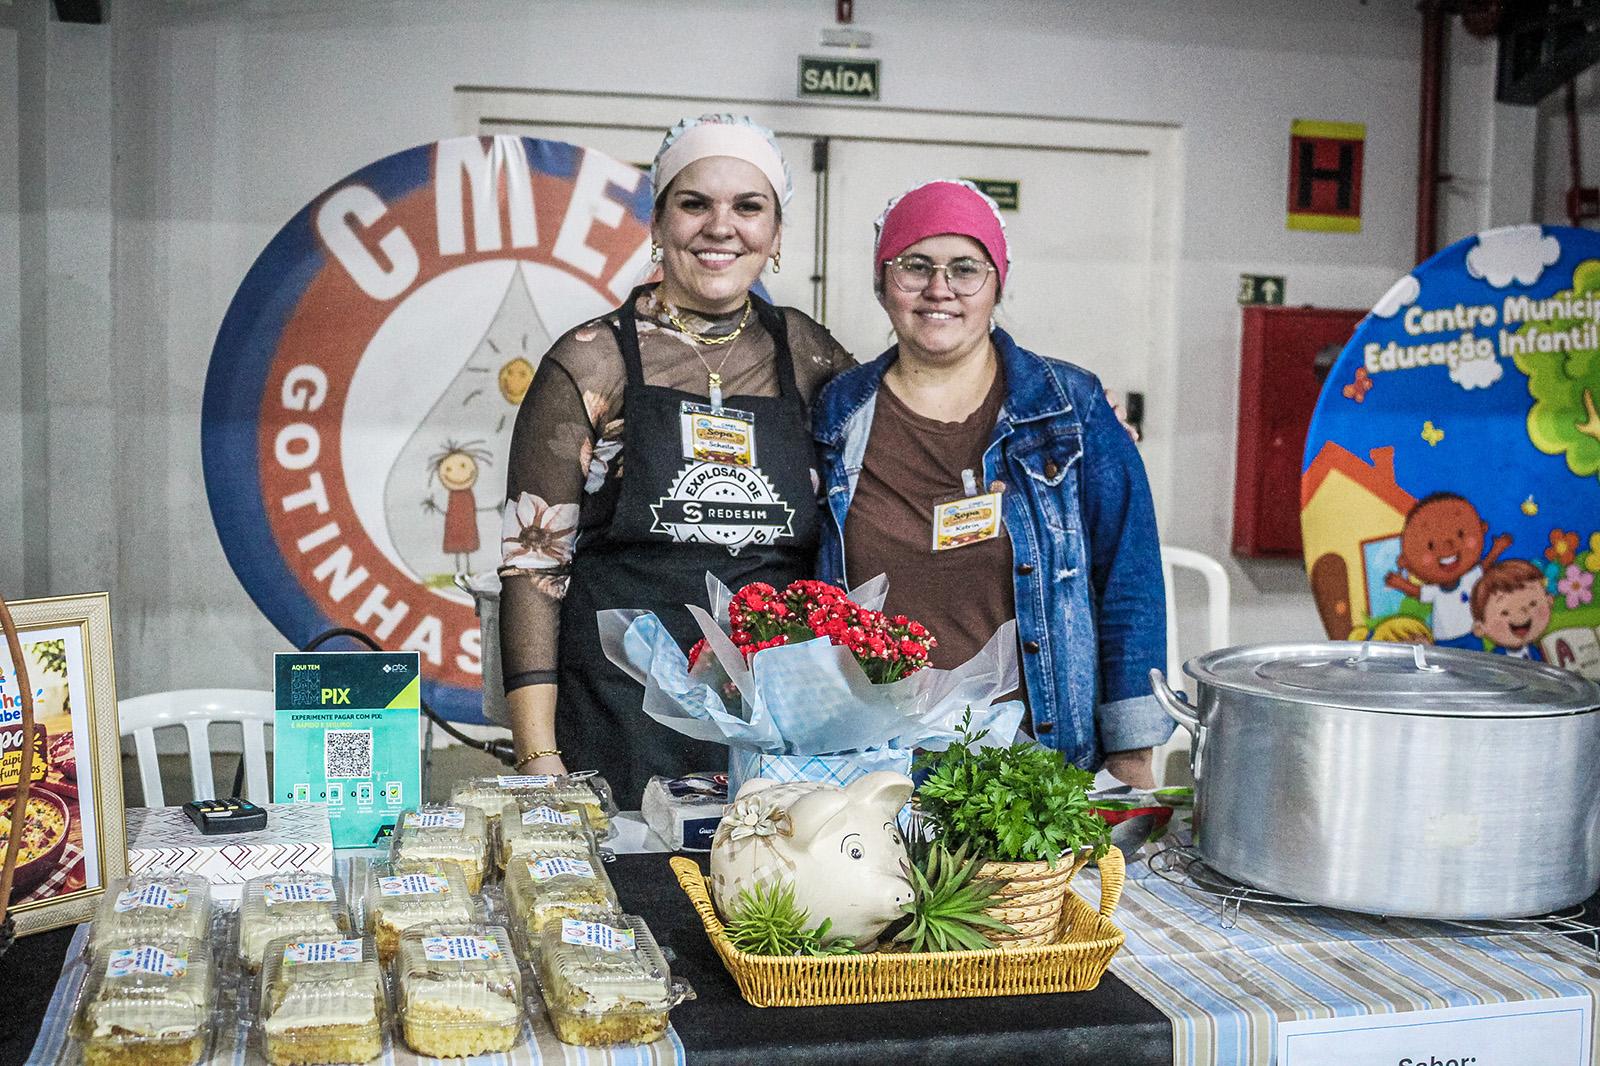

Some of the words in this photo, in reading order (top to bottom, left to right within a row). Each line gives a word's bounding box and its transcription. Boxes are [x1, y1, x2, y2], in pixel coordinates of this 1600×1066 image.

[804, 66, 873, 92] SAÍDA
[1297, 141, 1354, 210] H
[1404, 304, 1498, 335] Centro
[1364, 332, 1494, 373] Educação
[1499, 322, 1599, 356] Infantil
[747, 481, 762, 500] DE
[274, 364, 481, 674] GOTINHAS
[708, 509, 767, 519] REDESIM
[321, 688, 351, 705] PIX
[2, 753, 23, 768] aipi
